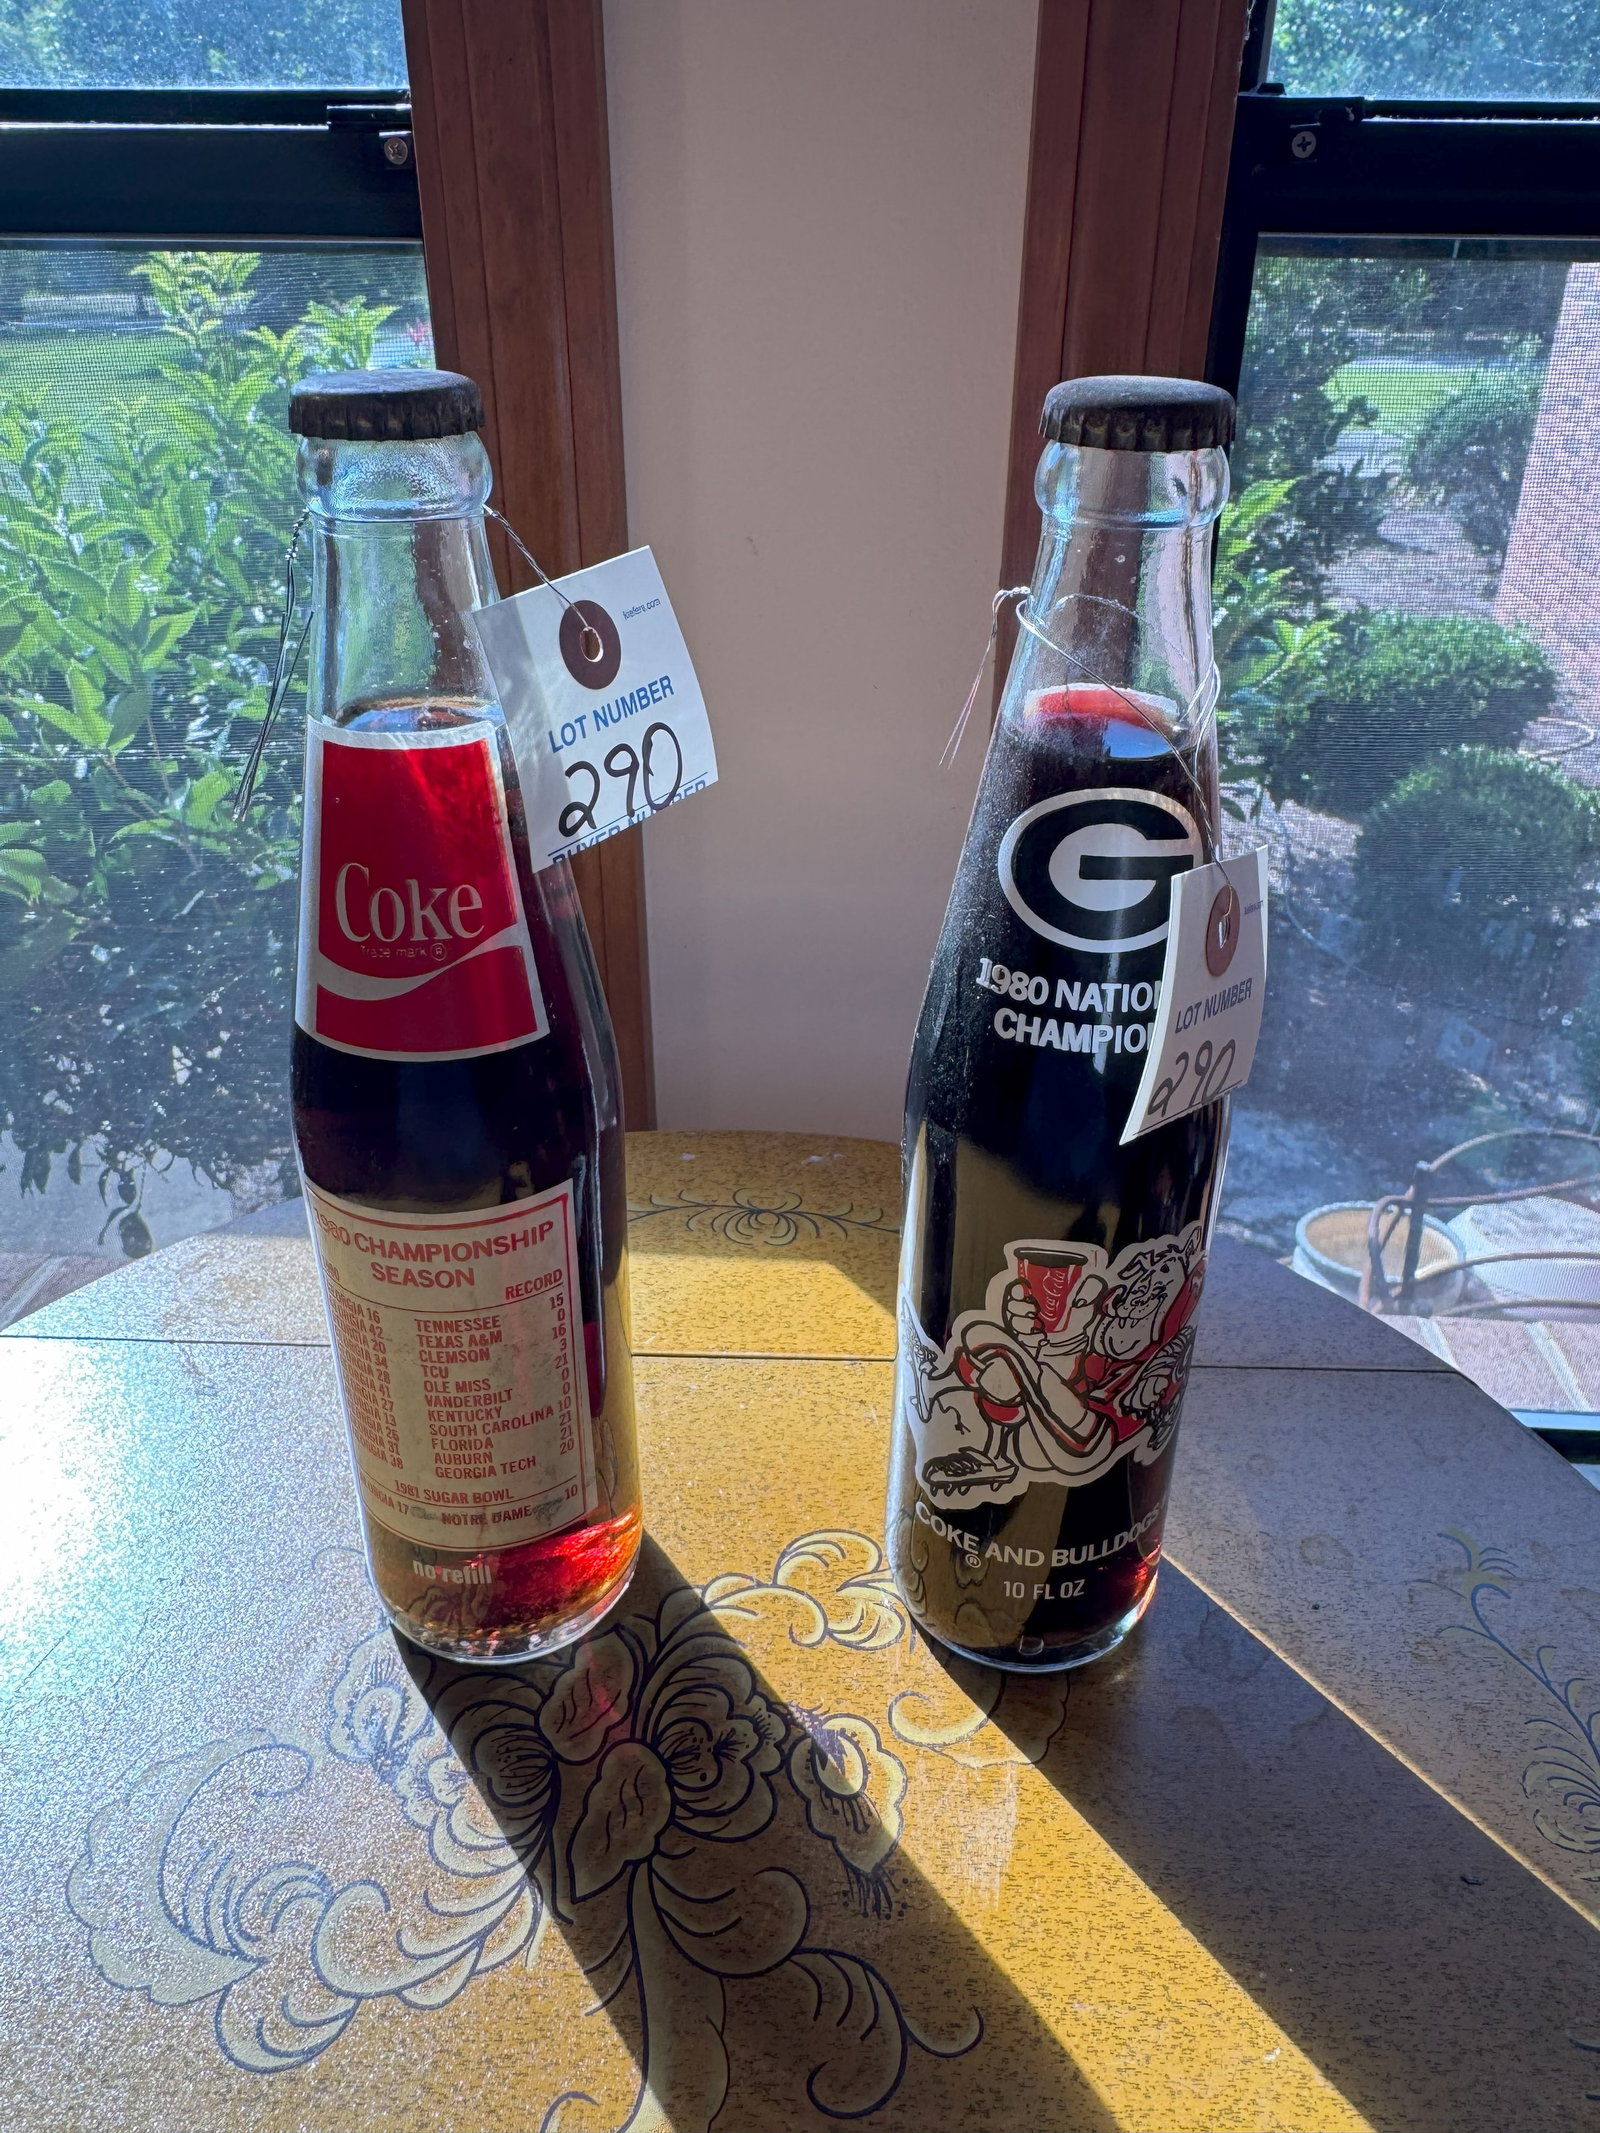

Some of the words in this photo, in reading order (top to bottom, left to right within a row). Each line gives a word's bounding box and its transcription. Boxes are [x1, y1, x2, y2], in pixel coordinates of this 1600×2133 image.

[549, 713, 587, 753] LOT
[594, 675, 675, 732] NUMBER
[559, 722, 682, 837] 290
[336, 862, 485, 943] Coke
[396, 947, 427, 958] mark
[976, 957, 1049, 1005] 1980
[1054, 979, 1162, 1013] NATIO
[1175, 1001, 1202, 1034] LOT
[1203, 978, 1252, 1021] NUMBER
[993, 1007, 1154, 1053] CHAMPIO
[1147, 1038, 1236, 1117] 290
[314, 1207, 351, 1246] 1980
[354, 1220, 554, 1263] CHAMPIONSHIP
[370, 1261, 475, 1289] SEASON
[505, 1268, 563, 1300] RECORD
[329, 1283, 365, 1318] EORGIA
[367, 1308, 380, 1324] 16
[414, 1315, 501, 1333] TENNESSEE
[549, 1292, 564, 1310] 15
[331, 1297, 367, 1333] ORGIA
[369, 1324, 384, 1339] 42
[416, 1334, 463, 1348] TEXAS
[468, 1330, 502, 1347] A&M
[557, 1308, 565, 1321] 0
[333, 1312, 370, 1349] ORGIA
[371, 1339, 386, 1354] 20
[419, 1347, 490, 1364] CLEMSON
[552, 1323, 567, 1340] 16
[336, 1327, 372, 1363] ORGIA
[420, 1364, 449, 1379] TCU
[560, 1337, 567, 1351] 3
[339, 1342, 374, 1378] ORGIA
[423, 1380, 451, 1394] OLE
[455, 1378, 491, 1393] MISS
[554, 1352, 568, 1369] 21
[341, 1357, 376, 1392] ORGIA
[424, 1389, 512, 1408] VANDERBILT
[562, 1367, 569, 1381] 0
[344, 1372, 379, 1407] ORGIA
[381, 1398, 394, 1412] 27
[427, 1406, 502, 1422] KENTUCKY
[563, 1381, 570, 1395] 0
[346, 1387, 381, 1421] ORGIA
[429, 1423, 477, 1437] SOUTH
[482, 1405, 554, 1435] CAROLINA
[558, 1396, 571, 1412] 10
[348, 1401, 384, 1436] ORGIA
[431, 1437, 494, 1452] FLORIDA
[559, 1410, 572, 1426] 21
[351, 1415, 386, 1449] ORGIA
[435, 1451, 493, 1465] AUBURN
[560, 1424, 572, 1440] 21
[353, 1427, 388, 1463] ORGIA
[435, 1465, 497, 1479] GEORGIA
[500, 1455, 536, 1474] TECH
[560, 1438, 574, 1455] 20
[361, 1474, 395, 1509] ORGIA
[398, 1502, 409, 1515] 17
[441, 1512, 488, 1526] NOTRE
[491, 1505, 532, 1524] DAME
[564, 1484, 578, 1500] 10
[395, 1480, 420, 1498] 1981
[423, 1489, 469, 1504] SUGAR
[472, 1488, 514, 1503] BOWL
[915, 1501, 980, 1554] COKE
[985, 1541, 1045, 1567] AND
[412, 1560, 436, 1579] no
[442, 1564, 492, 1585] refill
[1003, 1581, 1025, 1599] 10
[1033, 1583, 1055, 1600] FL
[1059, 1578, 1086, 1598] OZ
